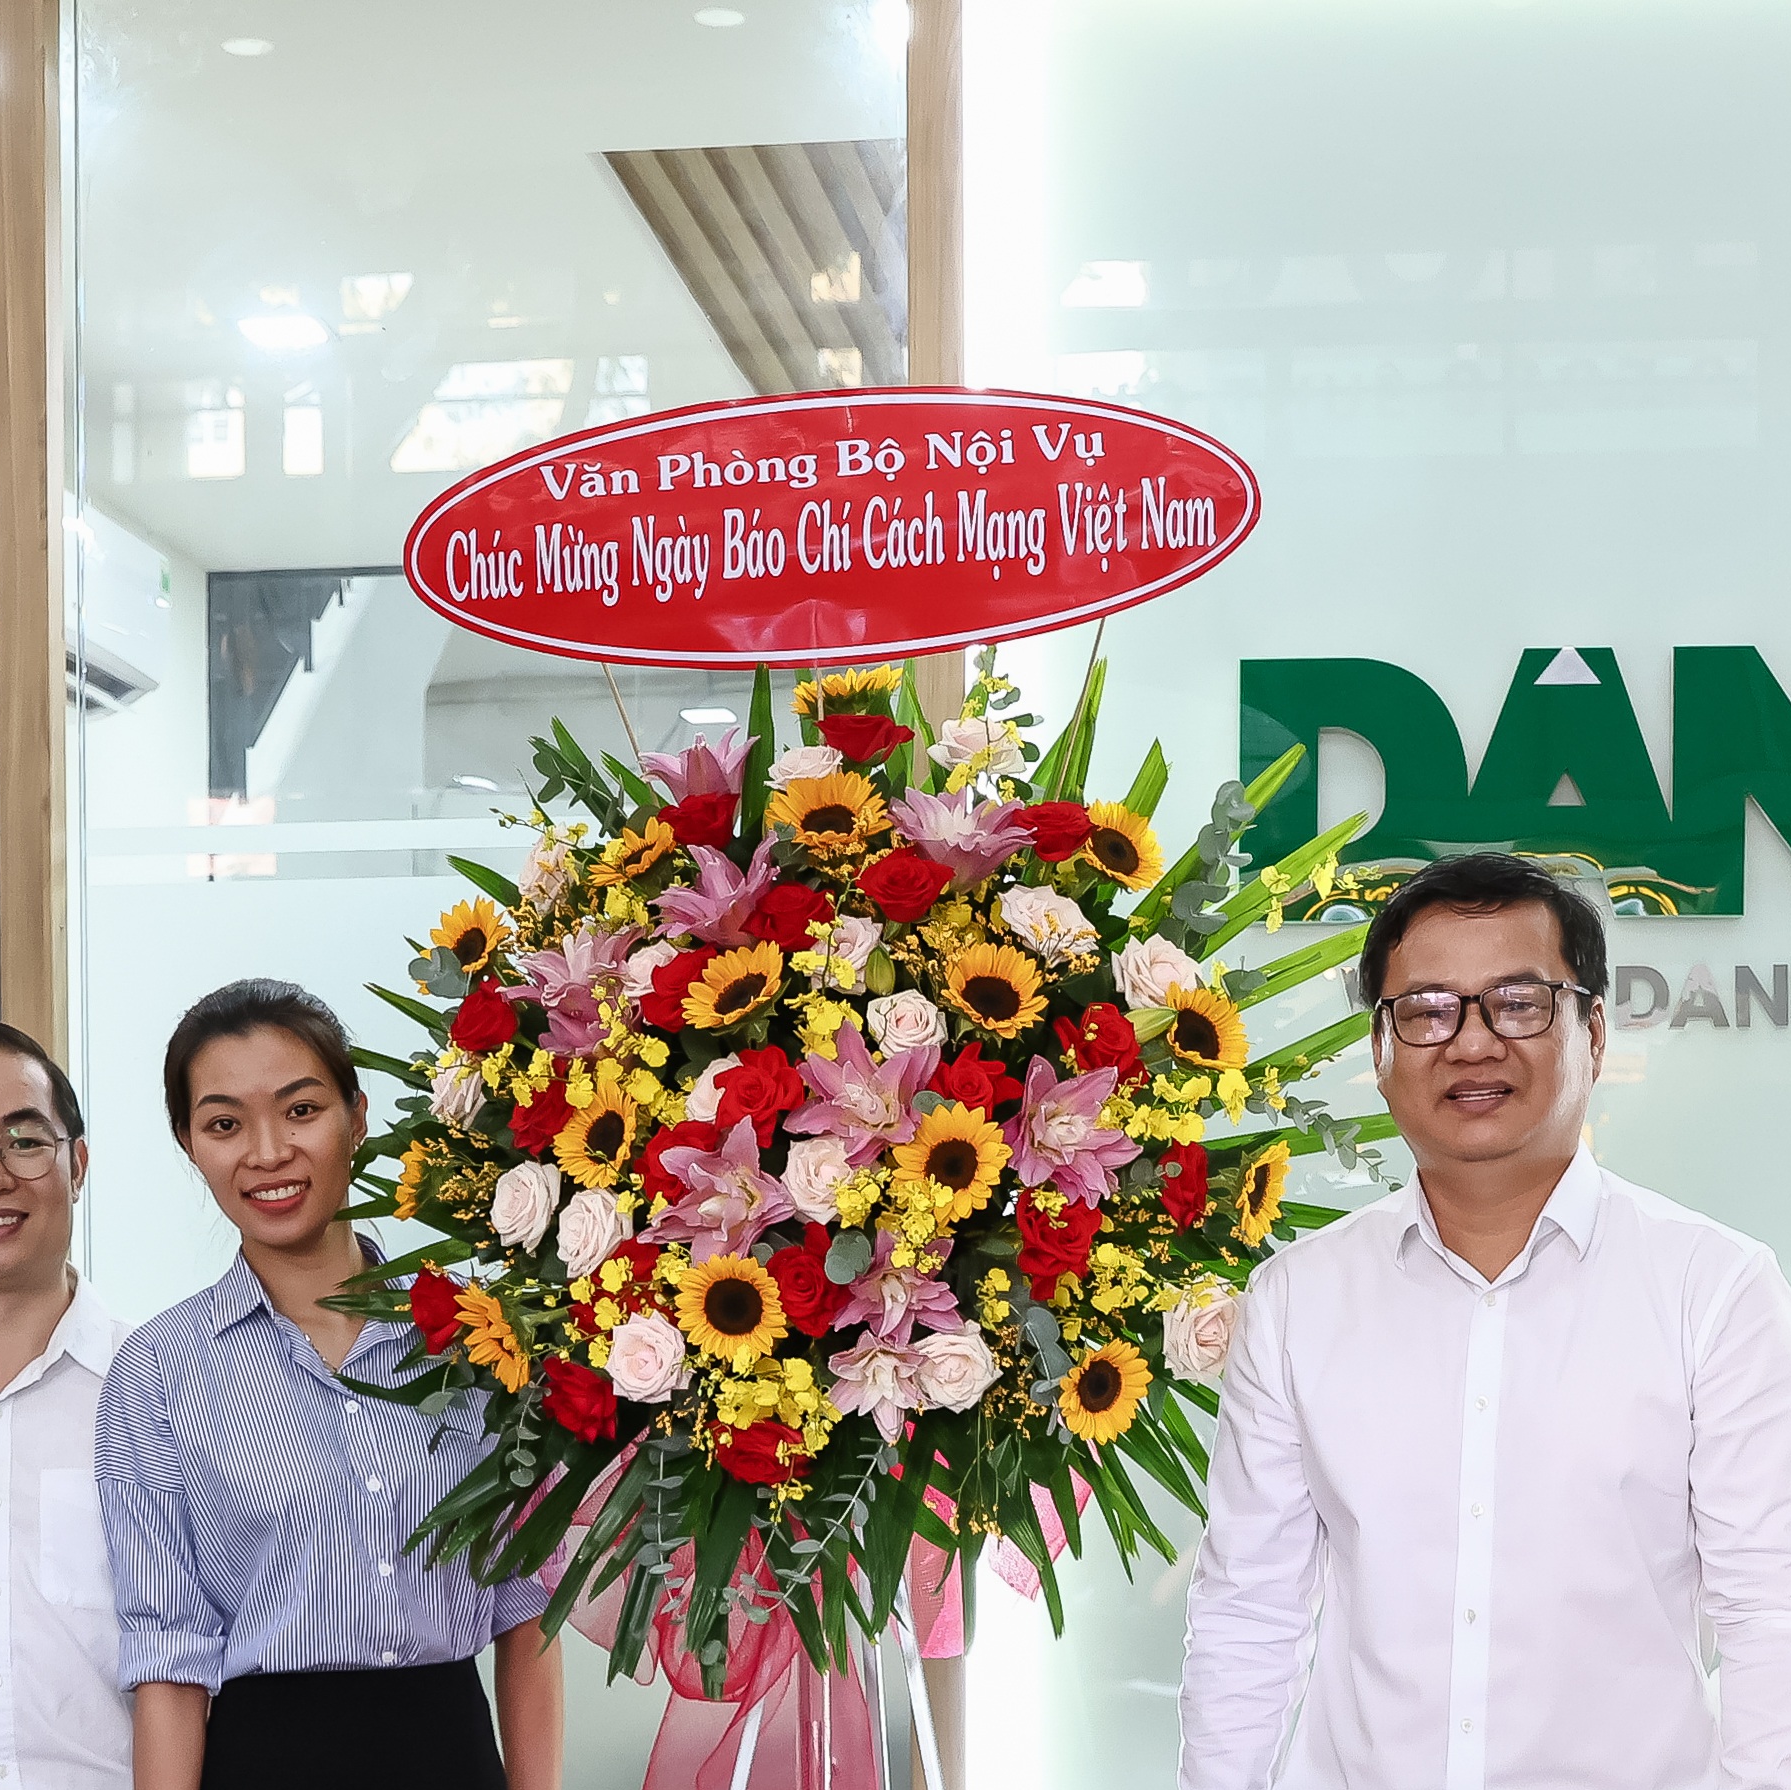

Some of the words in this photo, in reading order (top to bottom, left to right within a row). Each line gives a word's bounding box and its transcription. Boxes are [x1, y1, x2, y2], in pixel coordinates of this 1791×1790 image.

[539, 462, 640, 500] Văn
[657, 450, 818, 491] Phòng
[835, 437, 905, 481] Bộ
[924, 429, 1015, 470] Nội
[1031, 423, 1106, 466] Vụ
[446, 528, 524, 602] Chúc
[534, 523, 619, 607] Mừng
[631, 515, 710, 603] Ngày
[722, 508, 786, 579] Báo
[797, 499, 852, 574] Chí
[862, 490, 945, 569] Cách
[957, 489, 1046, 581] Mạng
[1057, 482, 1128, 573] Việt
[1141, 476, 1216, 555] Nam
